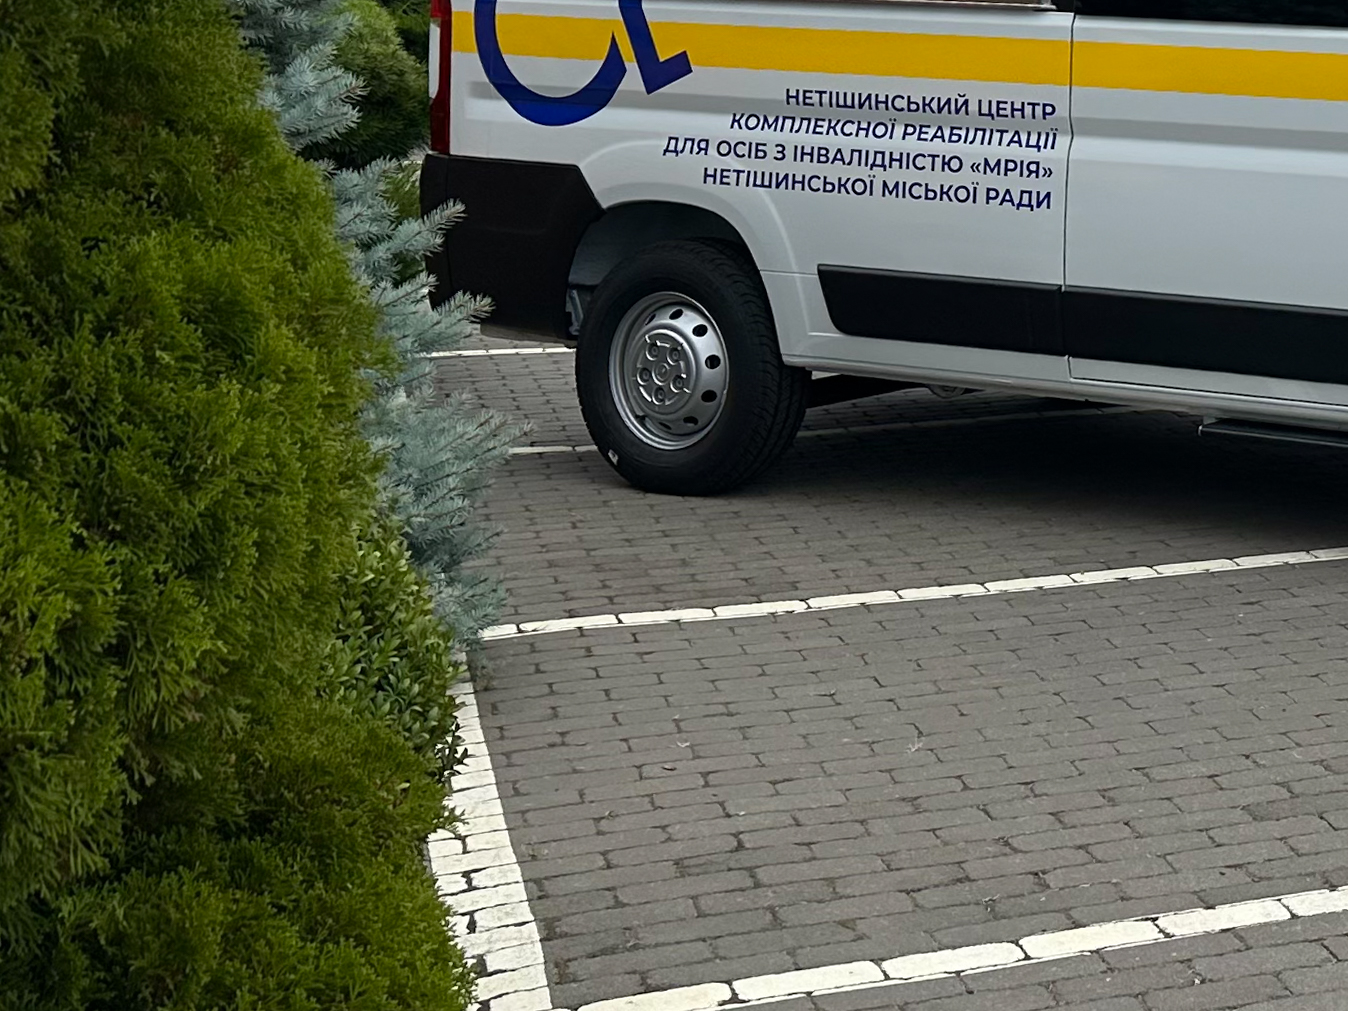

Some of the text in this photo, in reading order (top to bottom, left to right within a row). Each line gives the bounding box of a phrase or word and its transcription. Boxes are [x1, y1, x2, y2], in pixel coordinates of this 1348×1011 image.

[785, 88, 1057, 122] НЕТІШИНСЬКИЙ ЦЕНТР
[729, 112, 1059, 153] КОМПЛЕКСНОЇ РЕАБІЛІТАЦІЇ
[662, 136, 710, 158] ДЛЯ
[716, 139, 768, 160] ОСІБ
[792, 144, 964, 174] ІНВАЛІДНІСТЮ
[969, 157, 1054, 179] «МРІЯ»
[702, 166, 1052, 212] НЕТІШИНСЬКОЇ МІСЬКОЇ РАДИ
